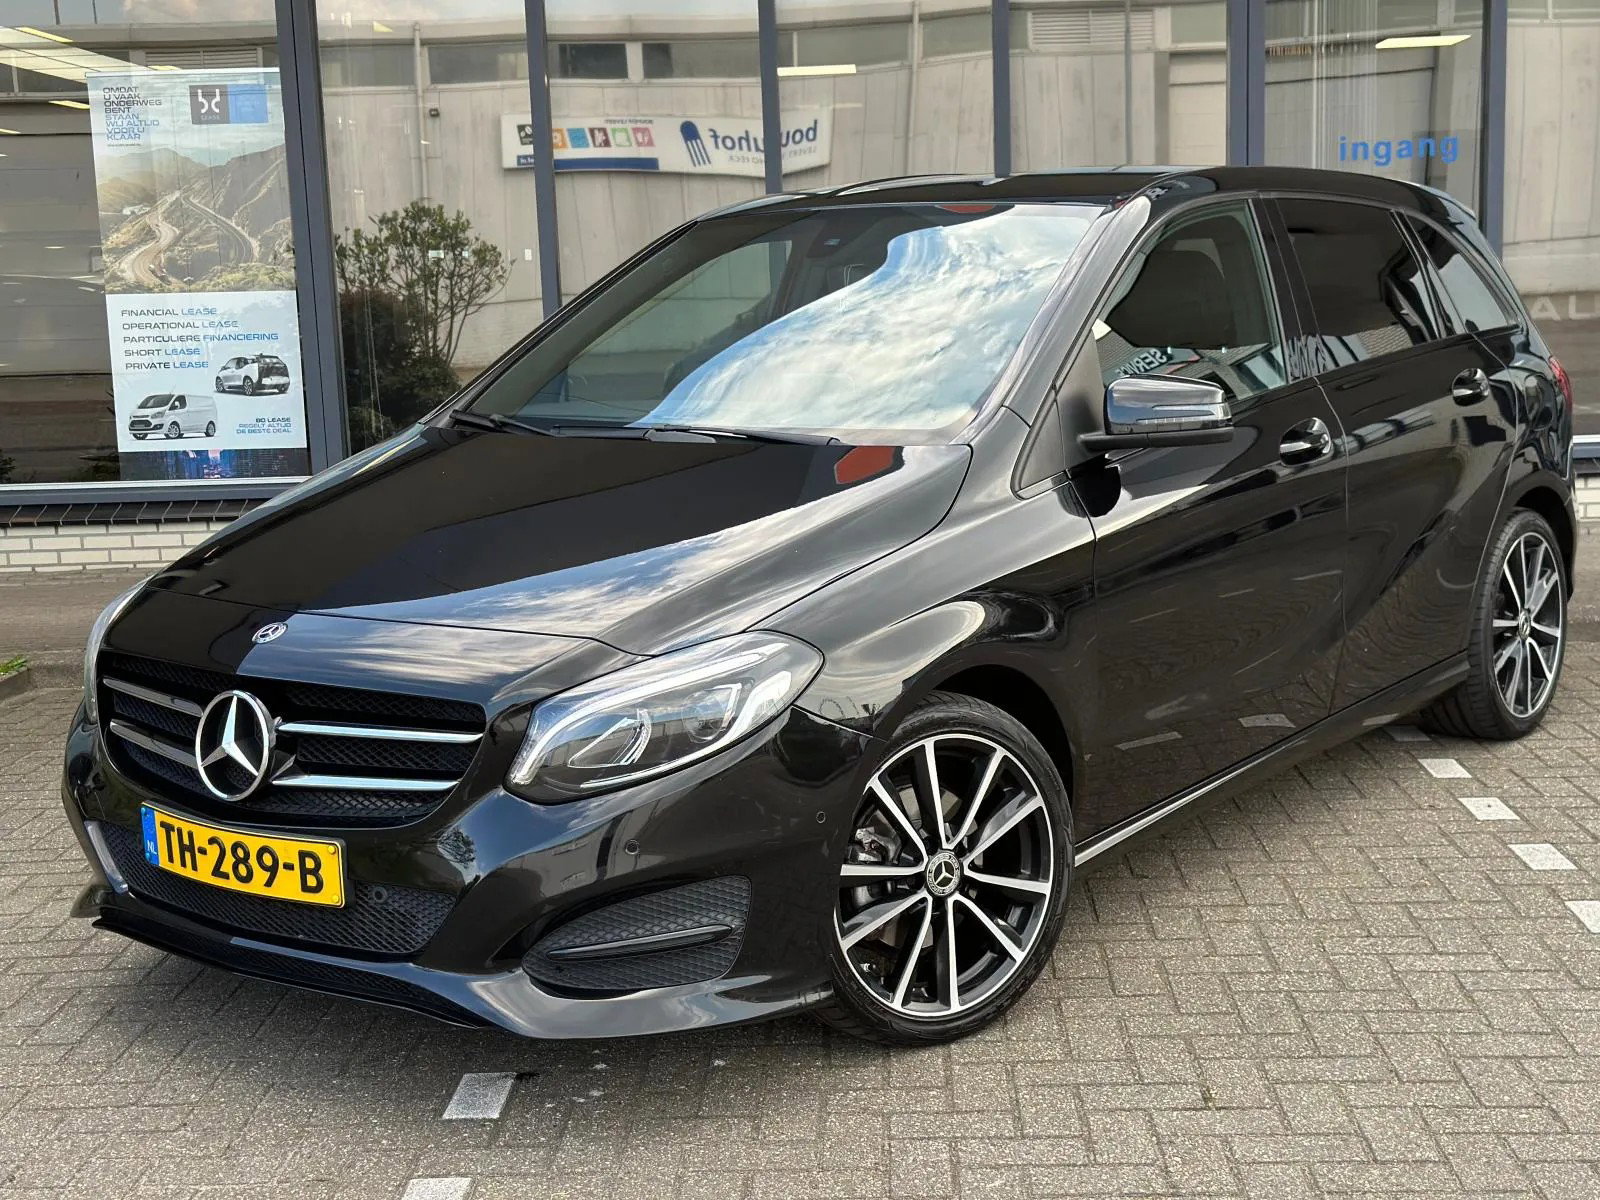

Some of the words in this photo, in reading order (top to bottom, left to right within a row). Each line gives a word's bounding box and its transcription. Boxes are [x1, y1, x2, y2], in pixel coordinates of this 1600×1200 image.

[126, 119, 159, 127] ALTIJD
[1339, 135, 1458, 167] ingang
[121, 309, 179, 317] FINANCIAL
[181, 307, 217, 316] LEASE
[122, 321, 200, 330] OPERATIONAL
[201, 320, 239, 328] LEASE
[123, 334, 200, 343] PARTICULIERE
[203, 332, 279, 342] FINANCIERING
[124, 348, 162, 357] SHORT
[164, 347, 200, 356] LEASE
[125, 361, 171, 370] PRIVATE
[172, 360, 208, 369] LEASE
[147, 840, 158, 855] NL
[160, 820, 324, 894] TH-289-B
